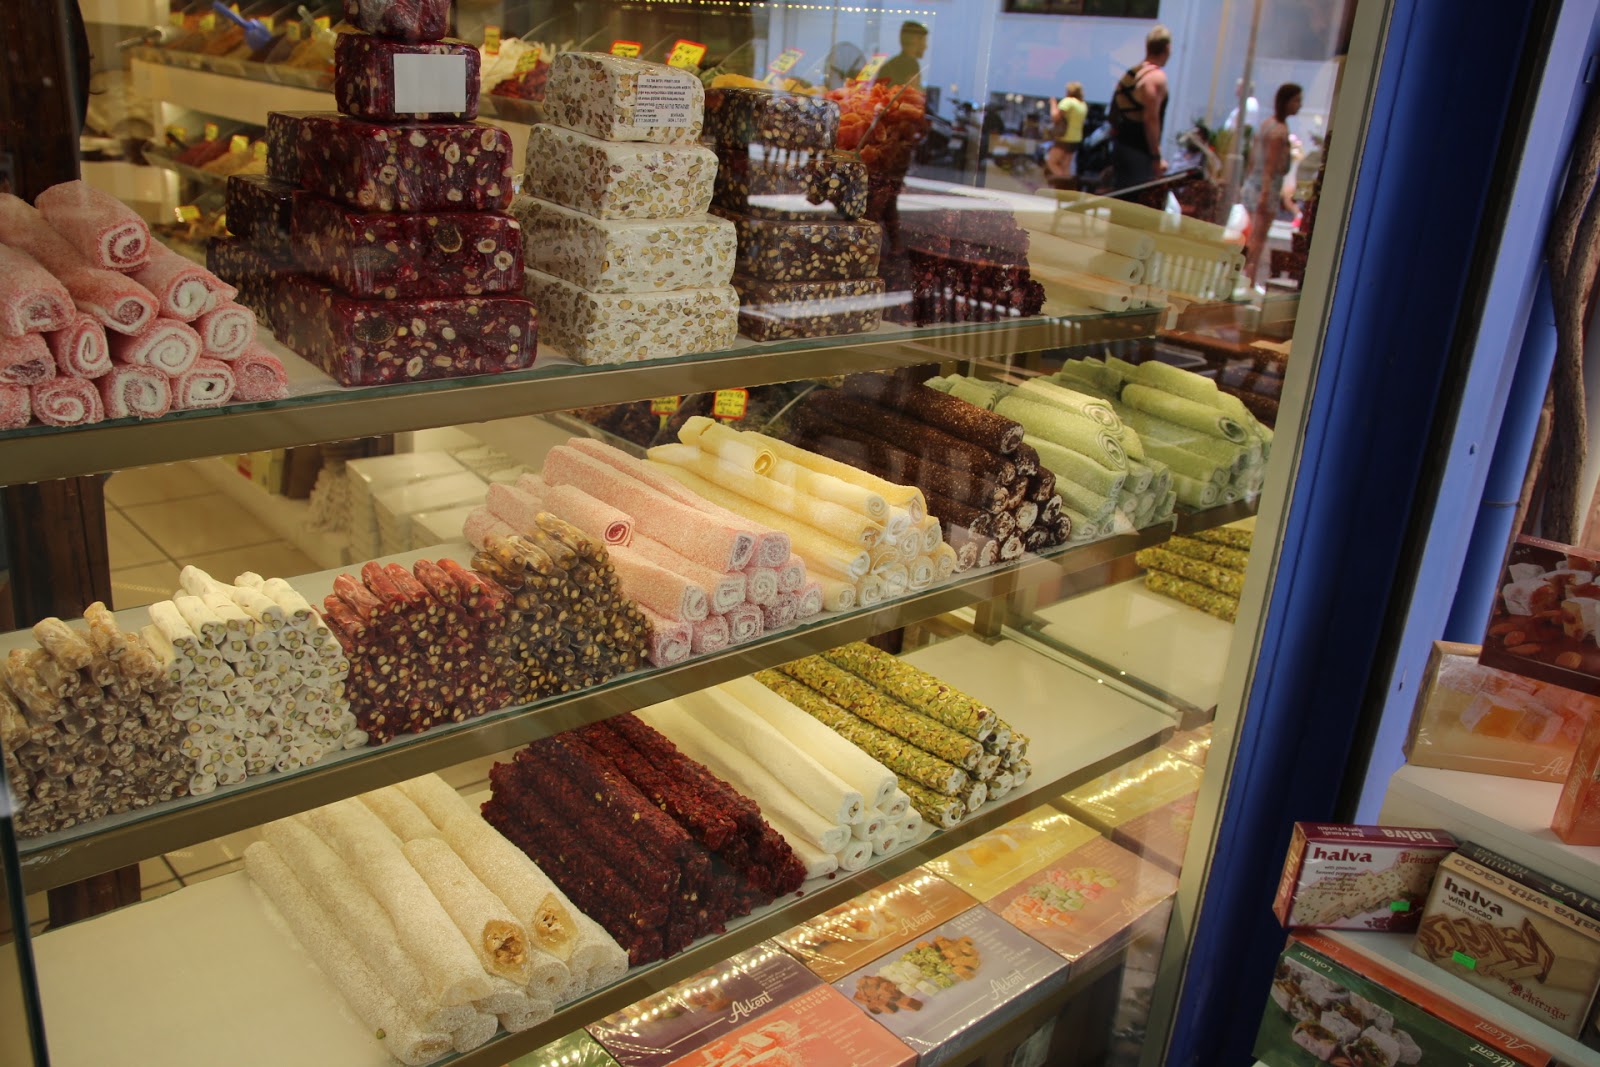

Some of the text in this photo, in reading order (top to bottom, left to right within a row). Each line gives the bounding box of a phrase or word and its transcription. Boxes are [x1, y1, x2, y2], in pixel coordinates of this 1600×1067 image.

[1381, 828, 1439, 842] helva
[1313, 847, 1373, 863] halva
[1453, 857, 1505, 884] cacao
[1444, 877, 1503, 917] halva
[1448, 895, 1493, 920] with cacao
[1506, 882, 1548, 908] with
[1550, 883, 1600, 911] alva
[900, 909, 936, 937] Akkent
[1300, 952, 1333, 973] Lokum
[990, 969, 1026, 1000] Akkent
[728, 990, 773, 1024] Akkent
[1475, 1022, 1536, 1051] Akkent
